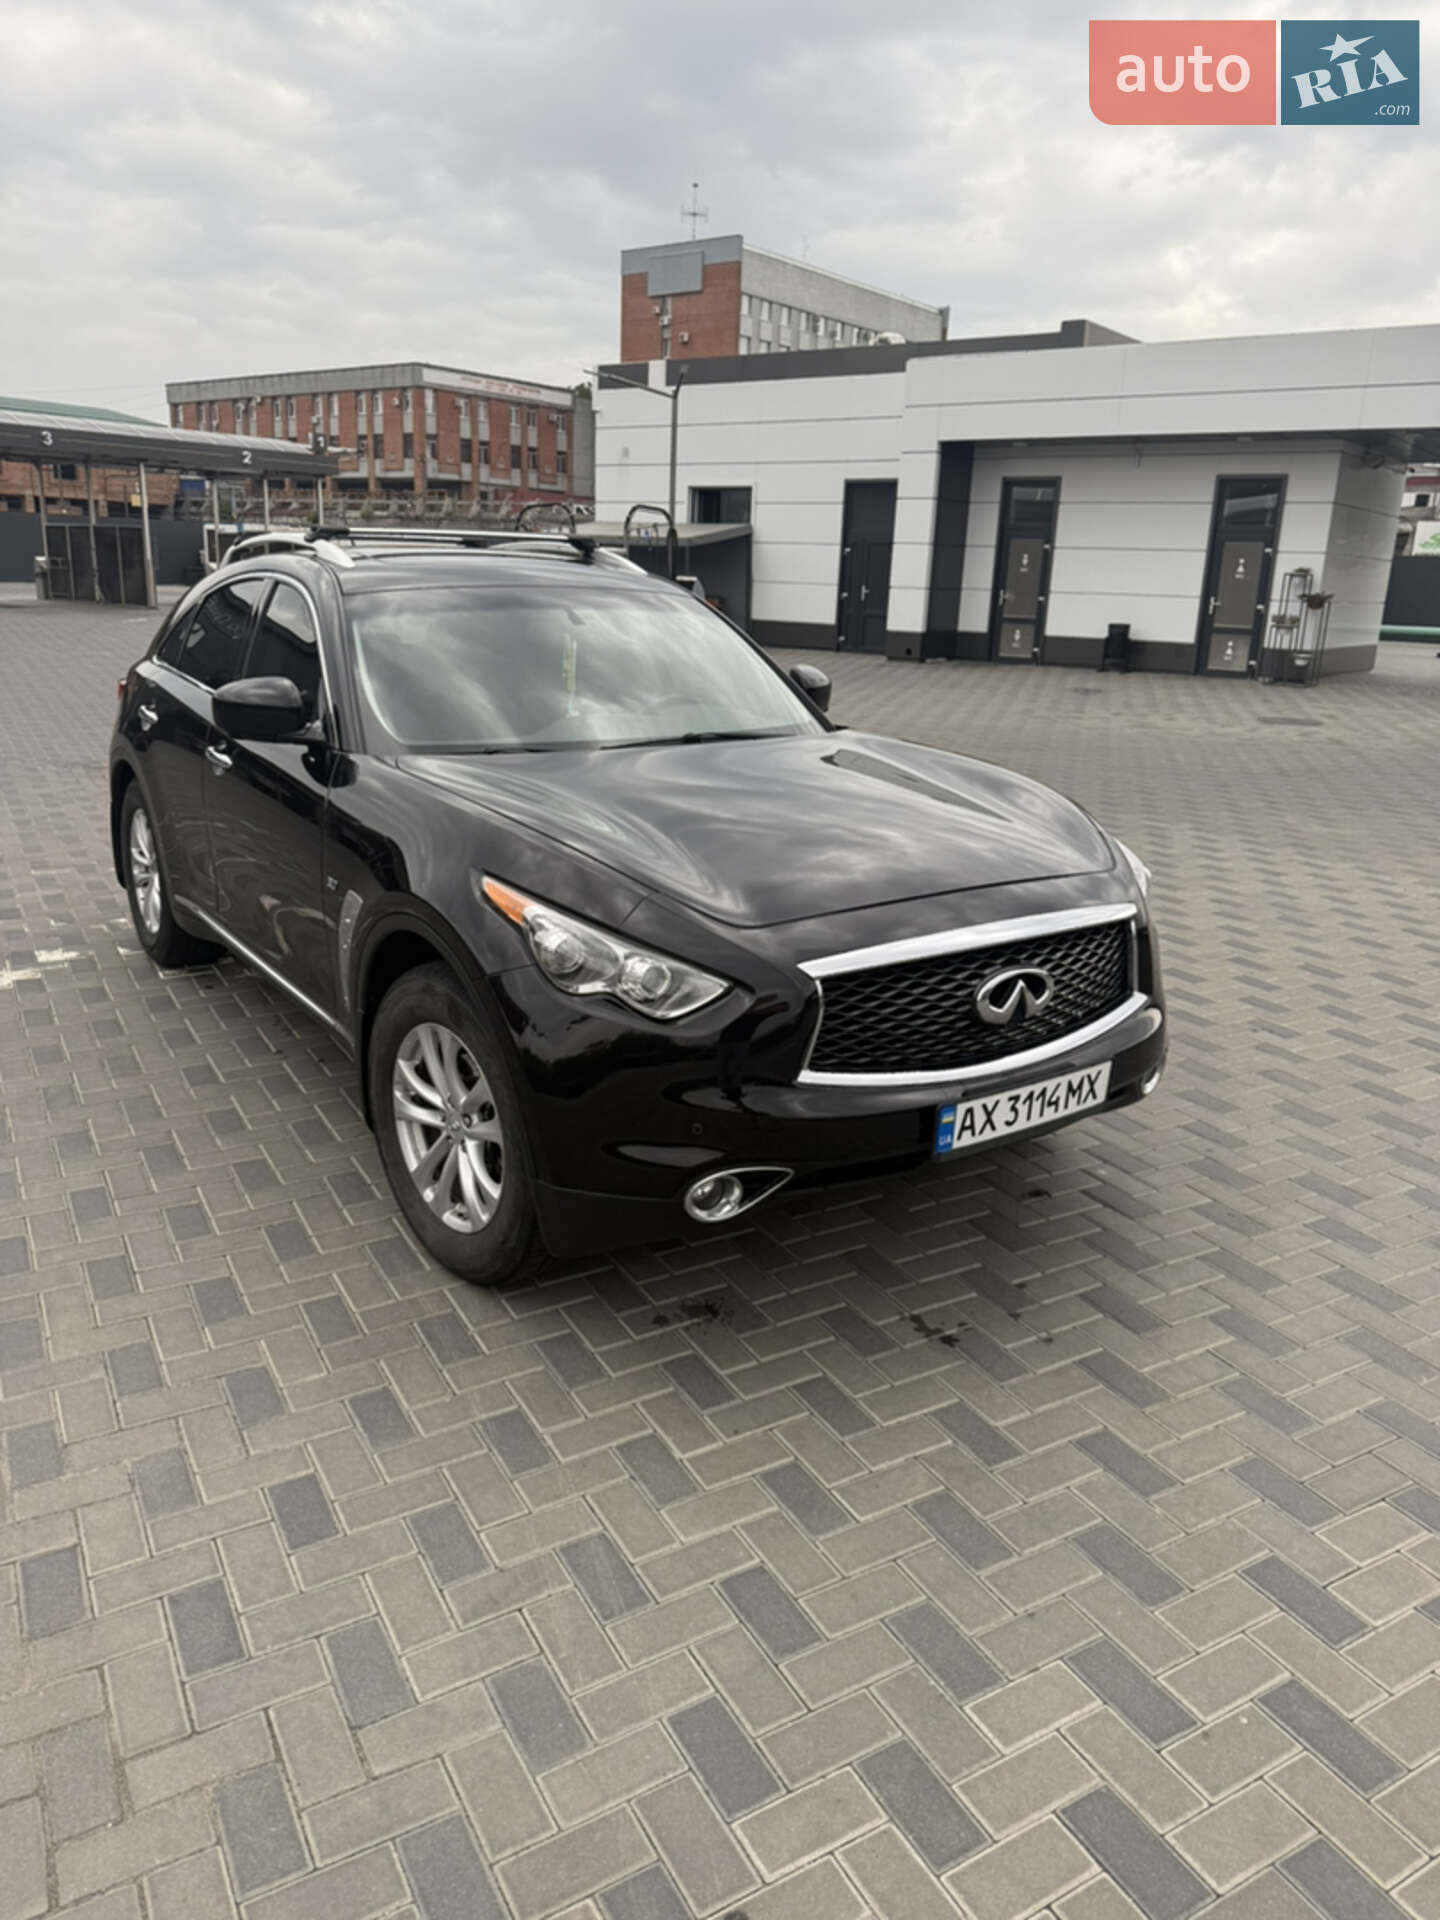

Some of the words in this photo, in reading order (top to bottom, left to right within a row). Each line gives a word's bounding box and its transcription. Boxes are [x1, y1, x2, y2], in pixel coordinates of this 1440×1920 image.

[41, 431, 53, 446] 3
[317, 436, 325, 448] 1
[242, 450, 253, 465] 2
[956, 1099, 1000, 1141] AX
[1004, 1082, 1062, 1127] 3114
